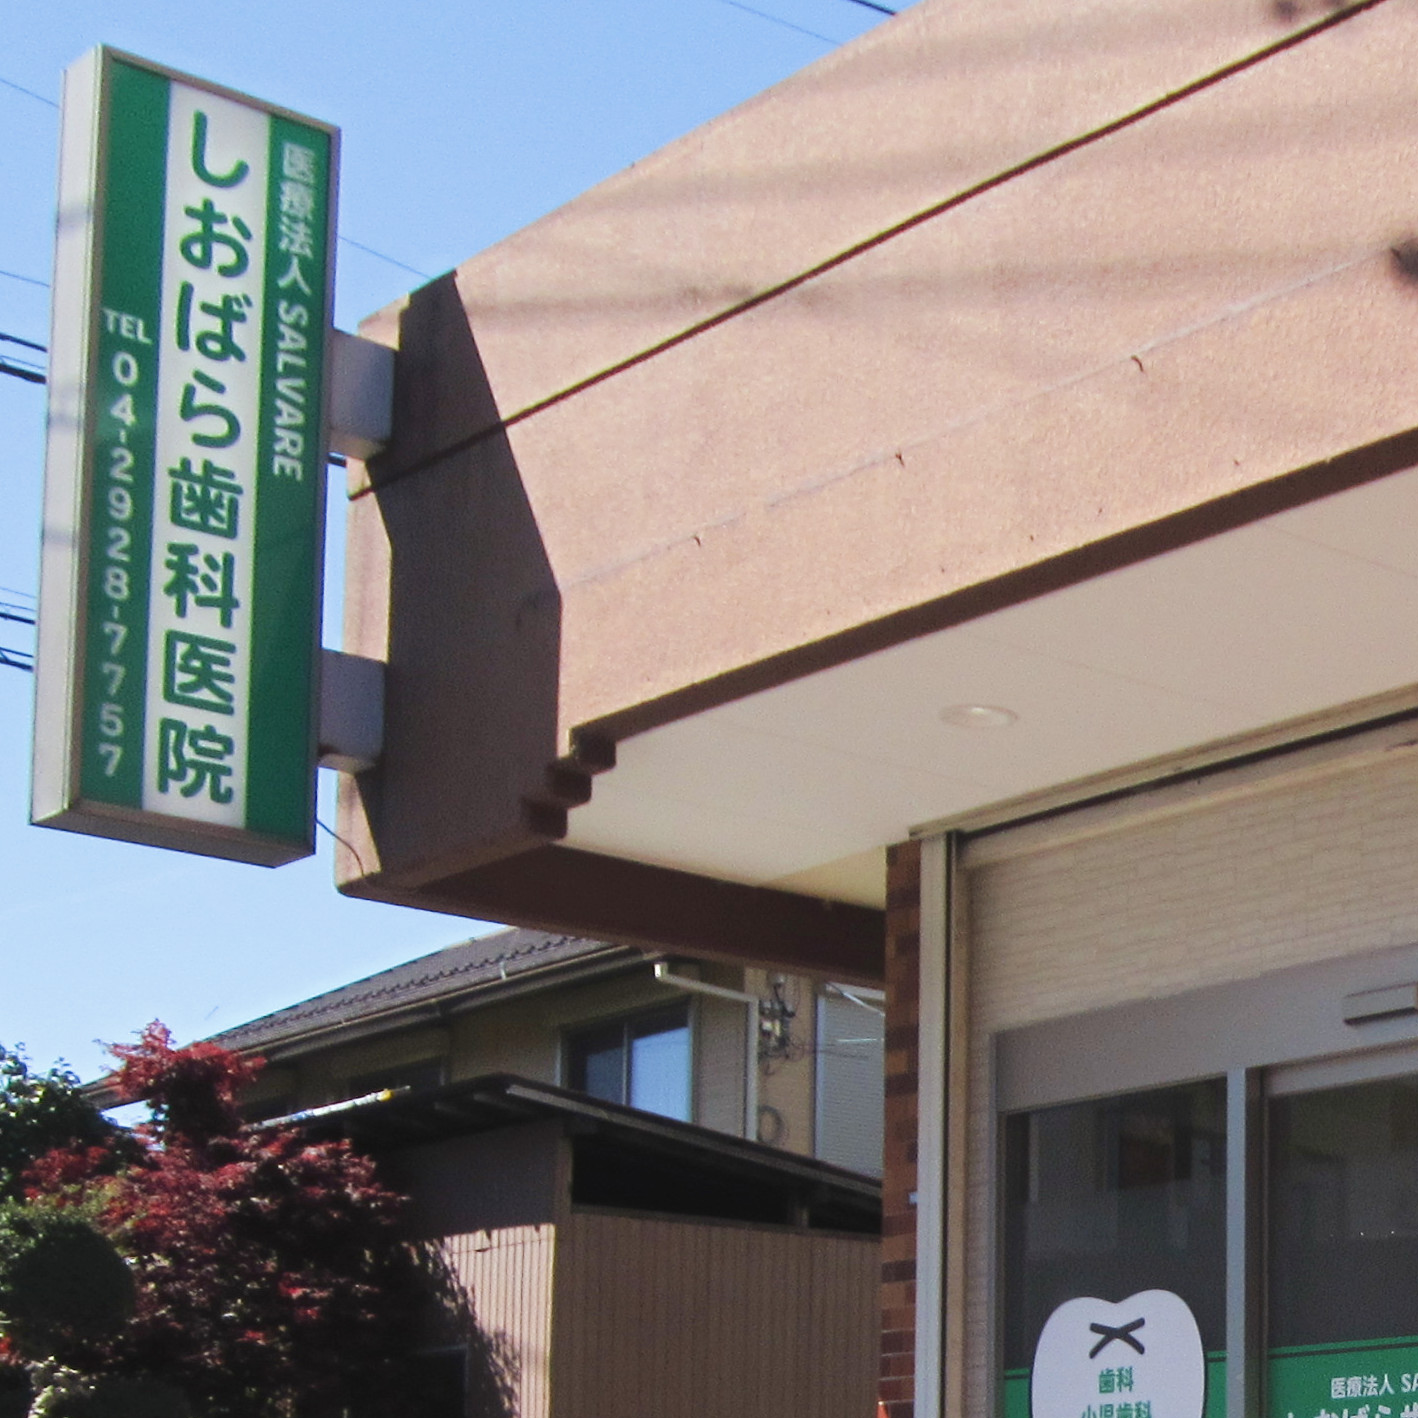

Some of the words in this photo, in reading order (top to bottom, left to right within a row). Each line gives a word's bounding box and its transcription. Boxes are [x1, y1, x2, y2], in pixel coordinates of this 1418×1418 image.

[103, 309, 152, 344] TEL
[272, 300, 308, 481] SALVARE
[157, 110, 252, 804] しおばら歯科医院
[98, 351, 138, 777] 04-2928-7757
[1098, 1365, 1134, 1394] 歯科
[1331, 1374, 1395, 1399] 医療法人
